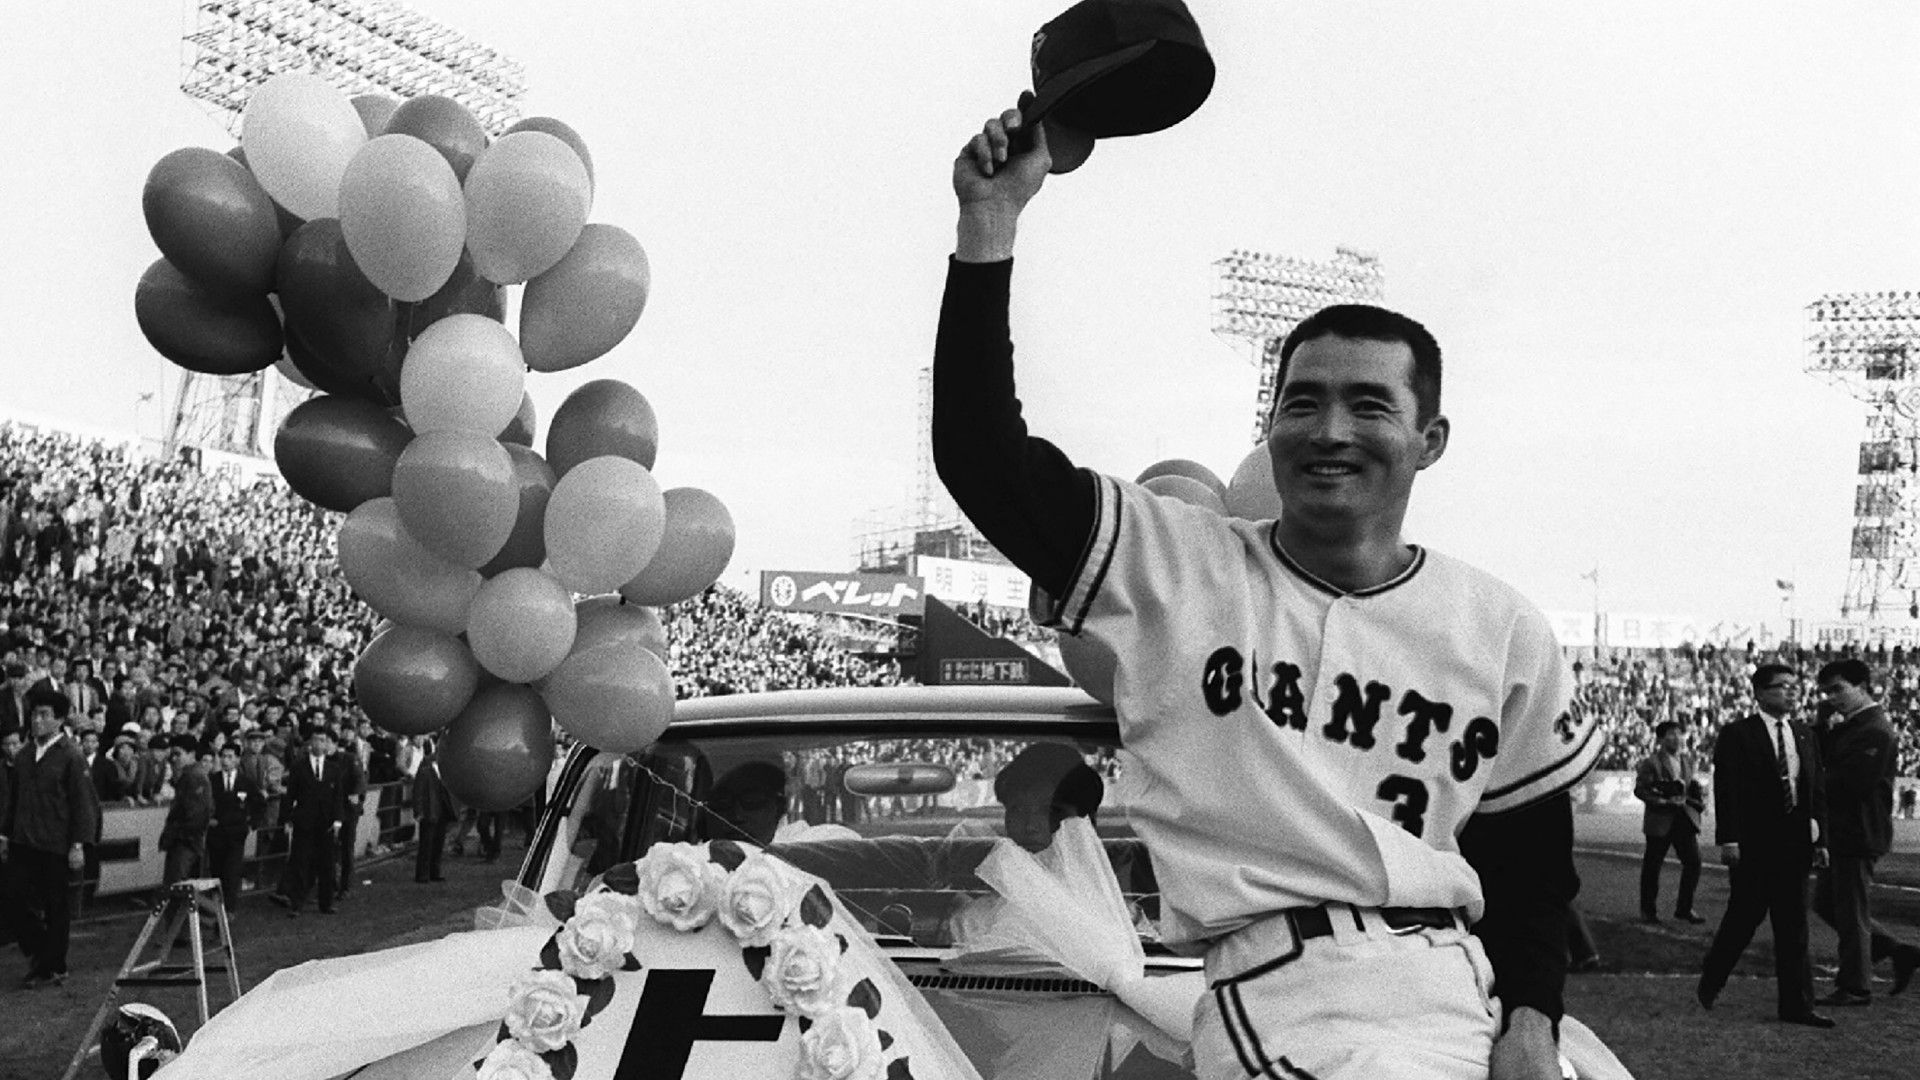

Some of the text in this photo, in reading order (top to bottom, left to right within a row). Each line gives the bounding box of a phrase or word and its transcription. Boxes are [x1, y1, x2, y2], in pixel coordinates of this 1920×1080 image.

[801, 580, 919, 607] ベレット
[1202, 646, 1499, 782] GANTS
[1376, 774, 1429, 838] 3
